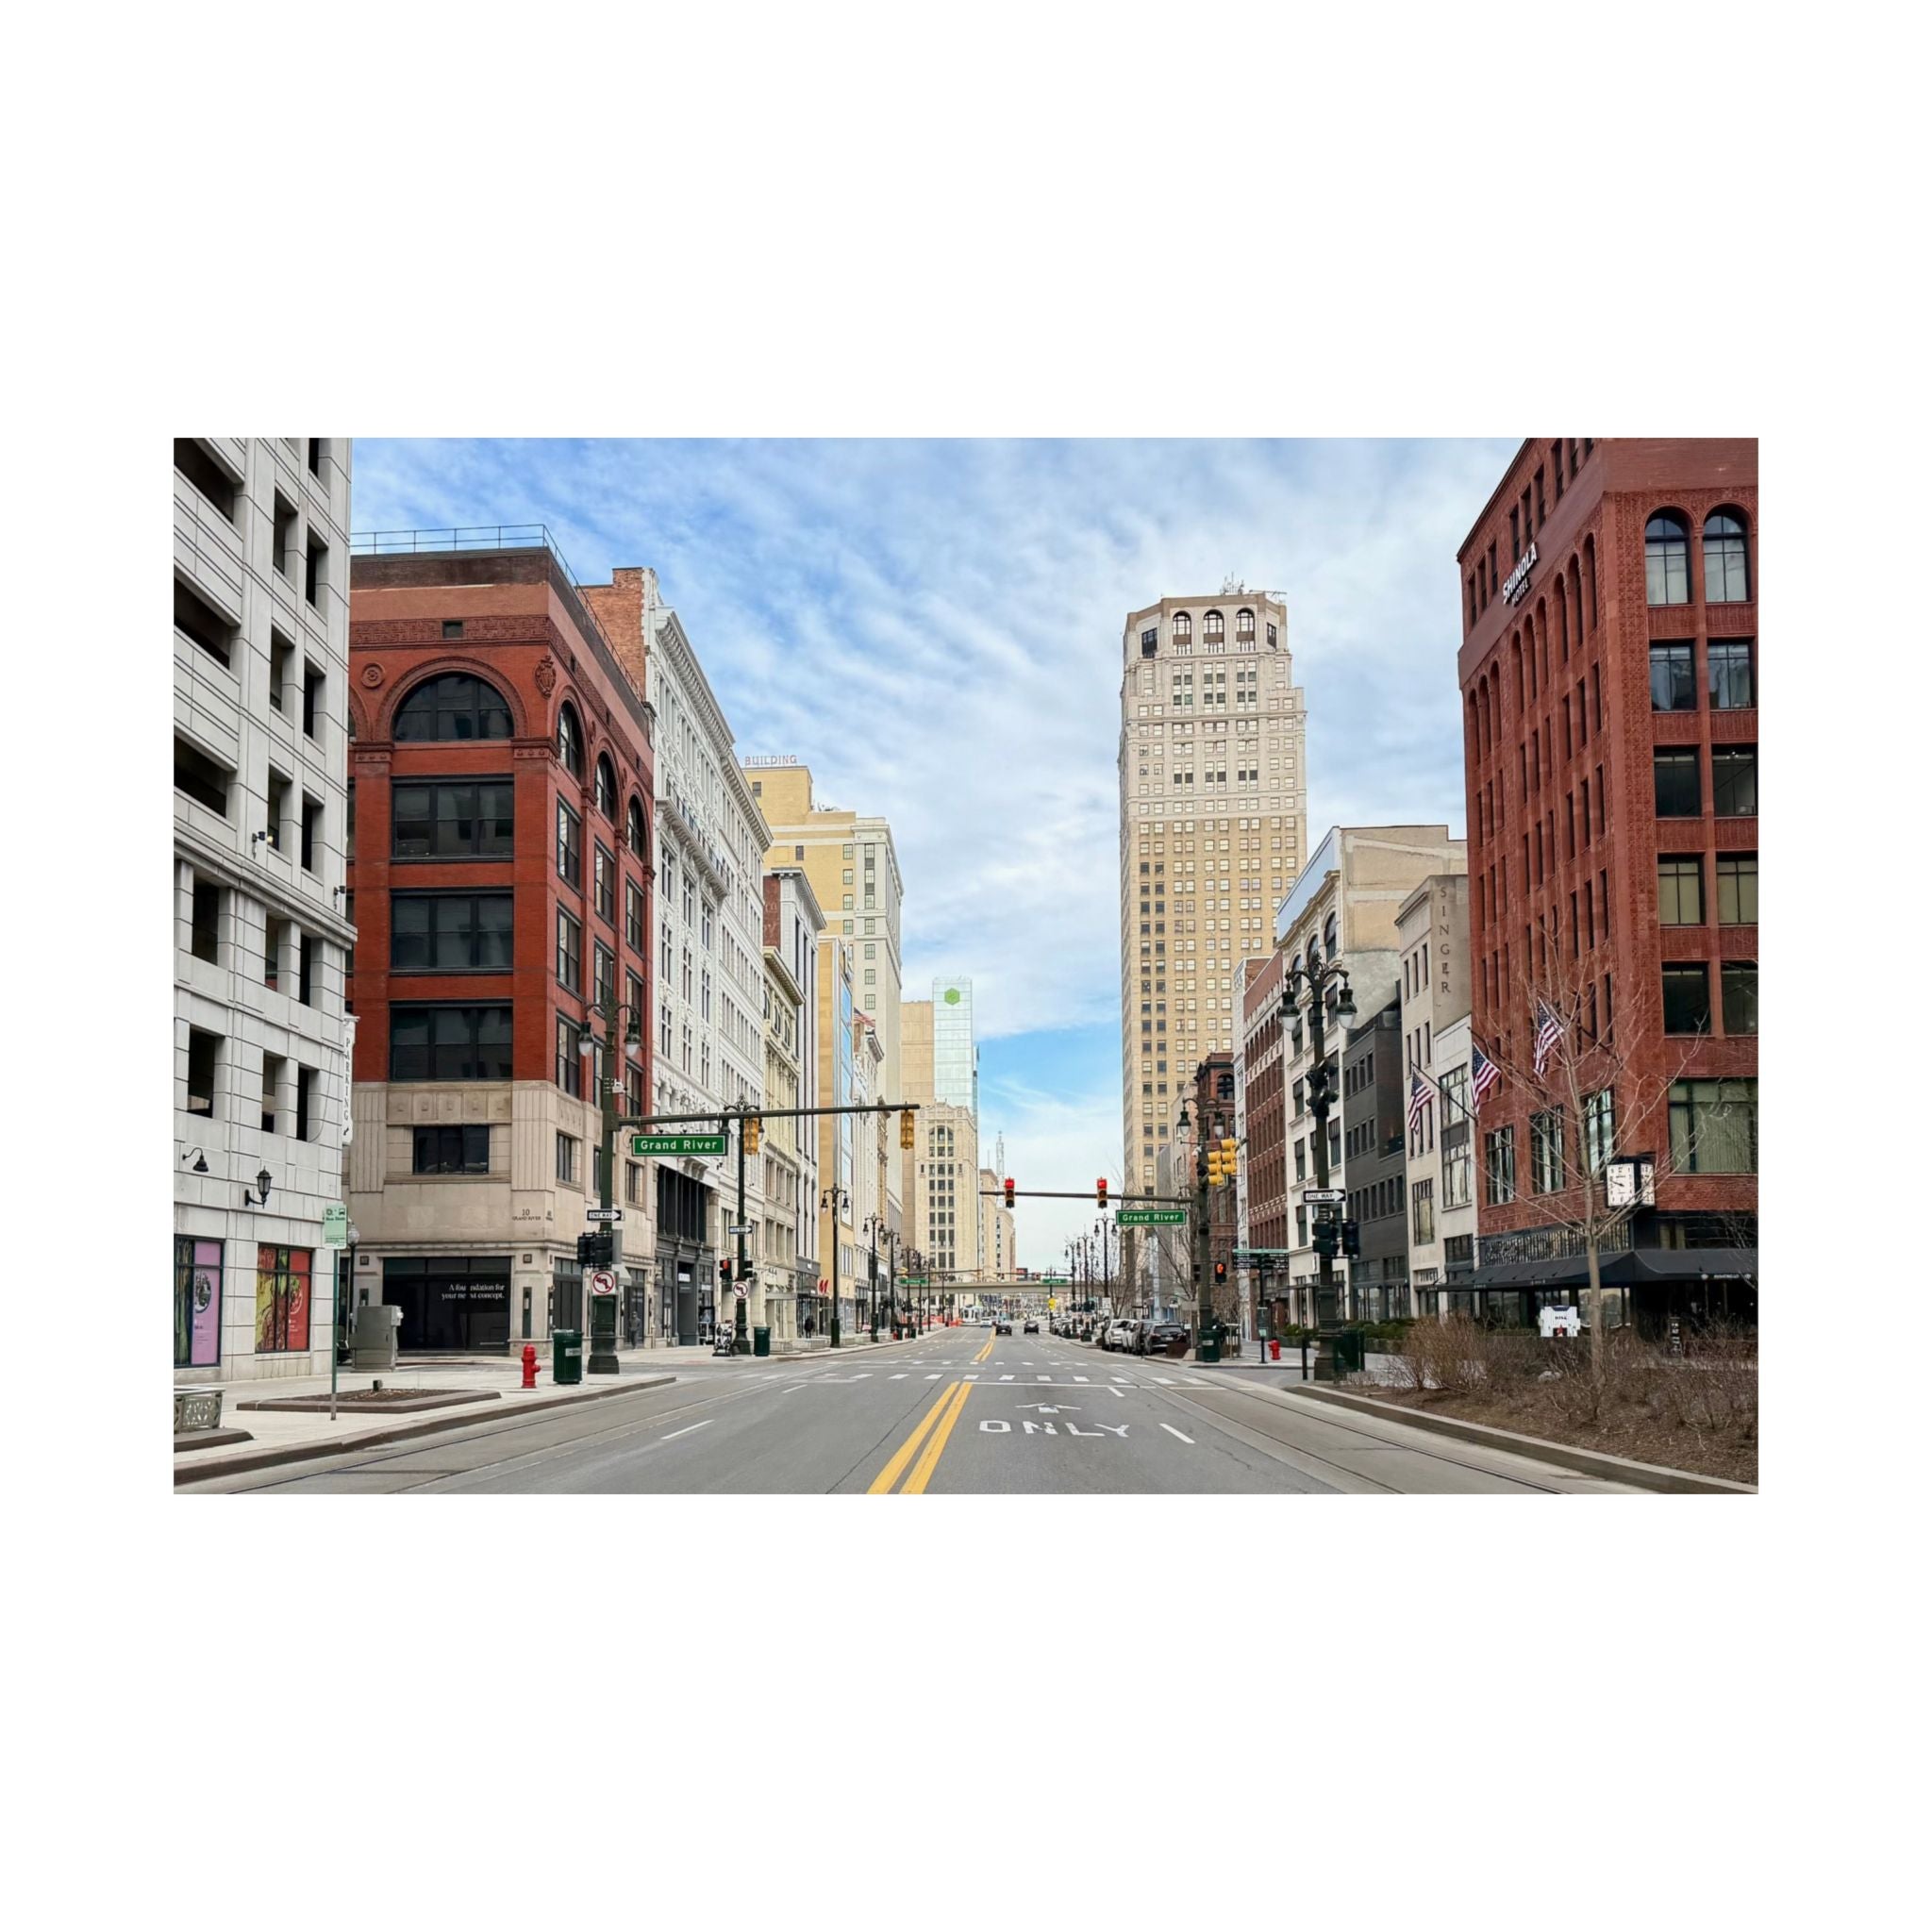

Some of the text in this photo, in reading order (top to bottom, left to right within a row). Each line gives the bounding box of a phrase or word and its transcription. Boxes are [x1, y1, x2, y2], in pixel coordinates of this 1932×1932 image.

[1503, 541, 1537, 605] SHINOLA
[1511, 577, 1528, 607] HOTEL
[745, 755, 797, 765] BUILDING
[1440, 887, 1451, 993] SINGER
[641, 1140, 718, 1150] Grand River
[1122, 1213, 1179, 1222] Grand River
[495, 1283, 506, 1291] for
[441, 1292, 457, 1301] your
[477, 1292, 506, 1301] concept.
[979, 1420, 1130, 1438] ONLY
